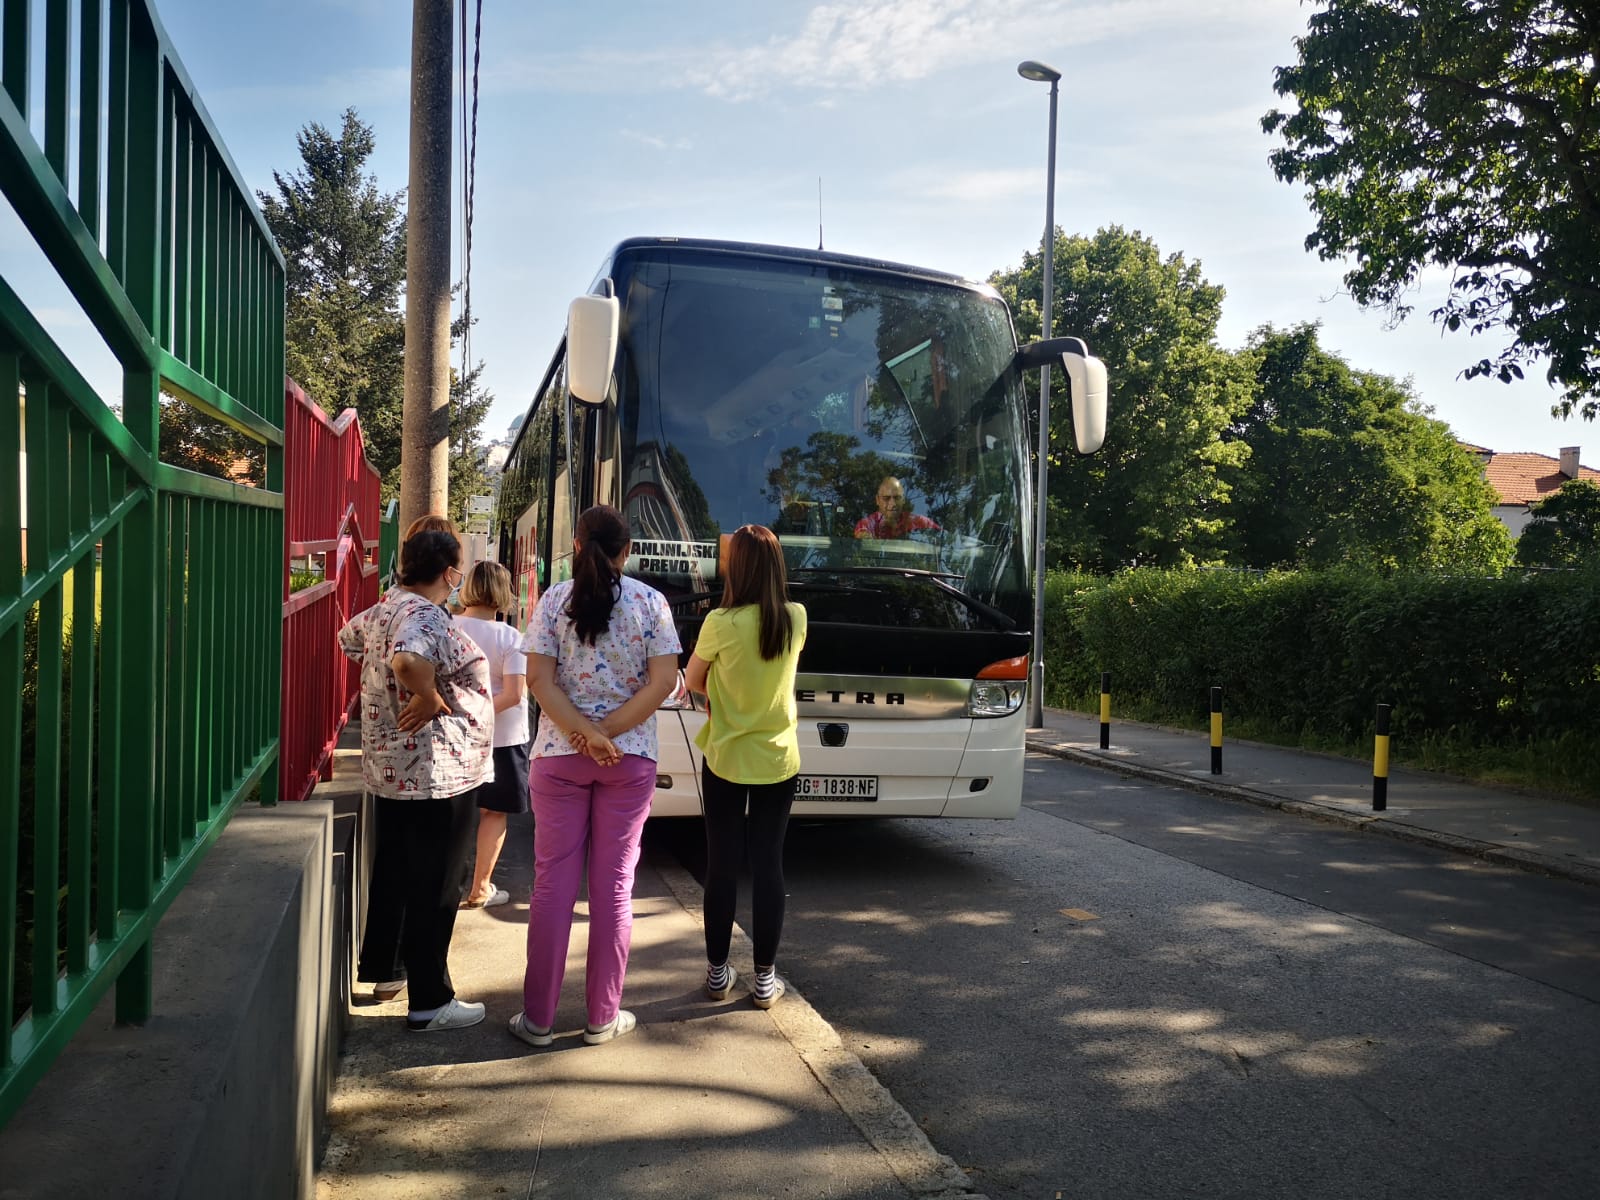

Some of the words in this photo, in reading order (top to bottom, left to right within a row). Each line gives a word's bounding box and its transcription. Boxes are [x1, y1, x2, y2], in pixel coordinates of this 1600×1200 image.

[630, 541, 717, 558] ANLINIJSKI
[639, 557, 698, 573] PREVOZ
[796, 689, 905, 705] ETRA
